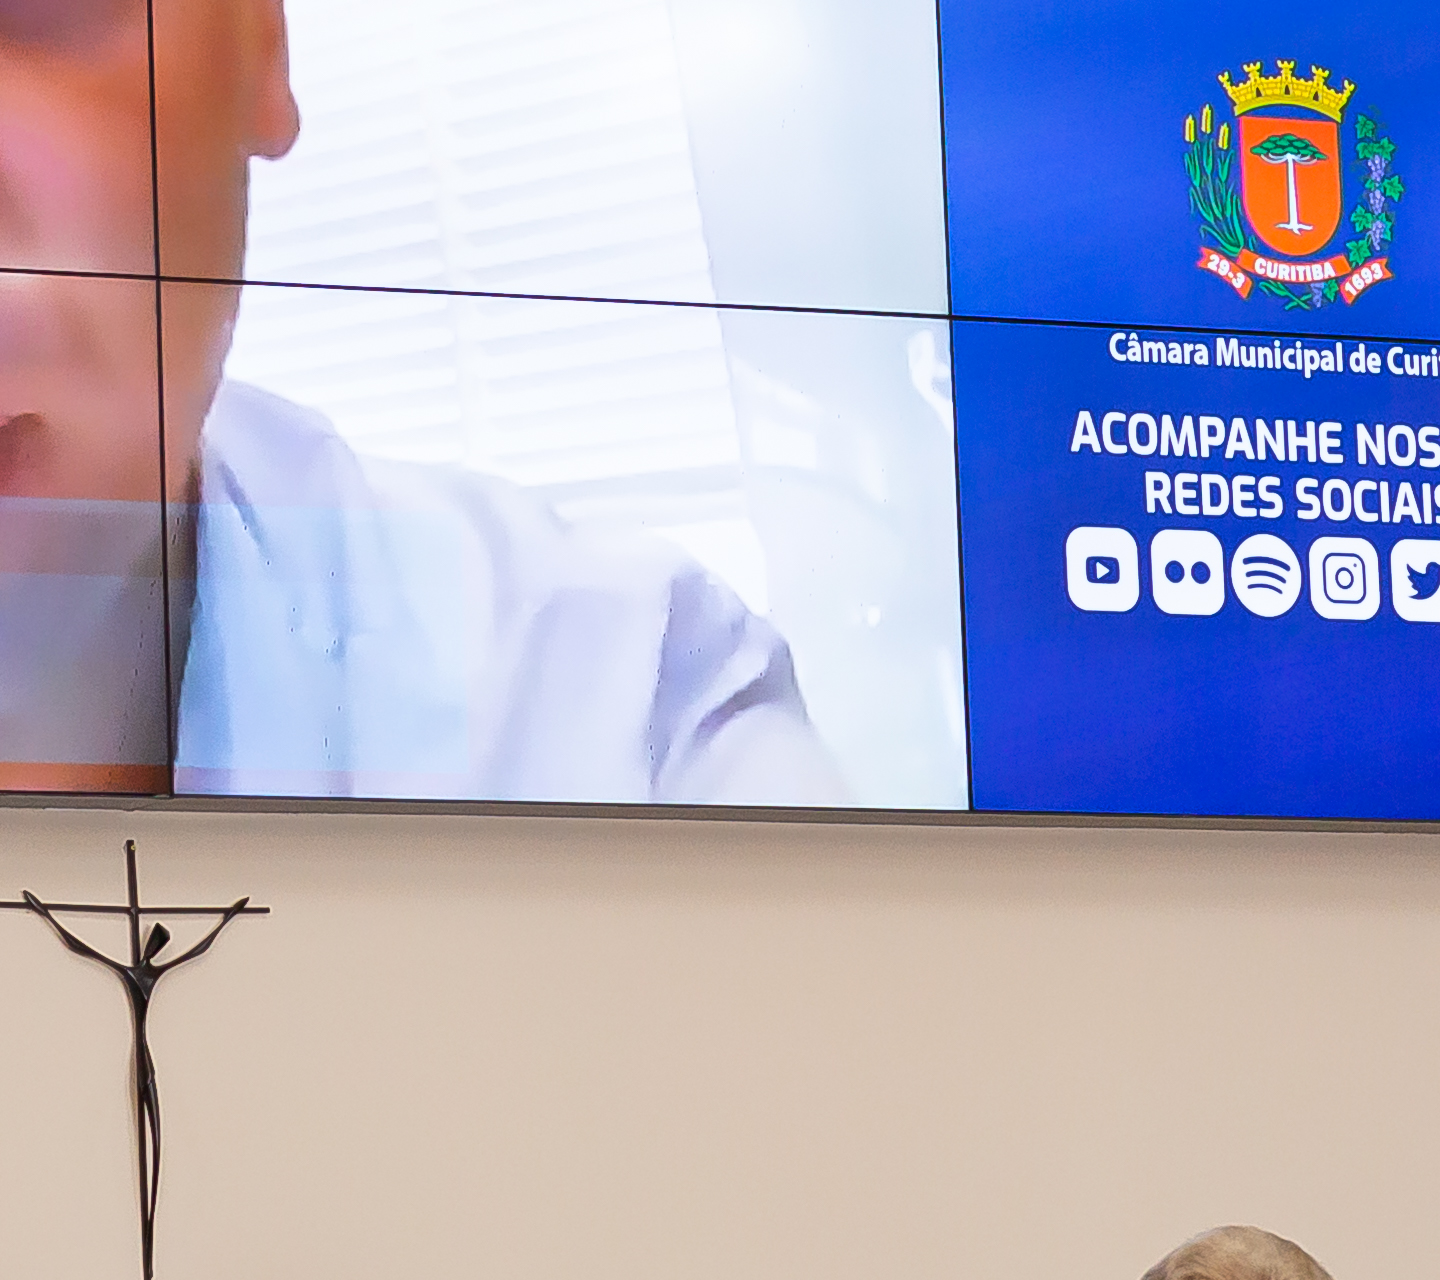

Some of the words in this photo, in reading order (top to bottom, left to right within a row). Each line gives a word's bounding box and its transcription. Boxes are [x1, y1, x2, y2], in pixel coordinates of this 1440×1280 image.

[1254, 257, 1336, 282] CURITIBA
[1344, 263, 1384, 296] 1693
[1109, 332, 1210, 367] Câmara
[1216, 337, 1344, 379] Municipal
[1349, 343, 1383, 374] de
[1070, 410, 1344, 464] ACOMPANHE
[1145, 471, 1283, 518] REDES
